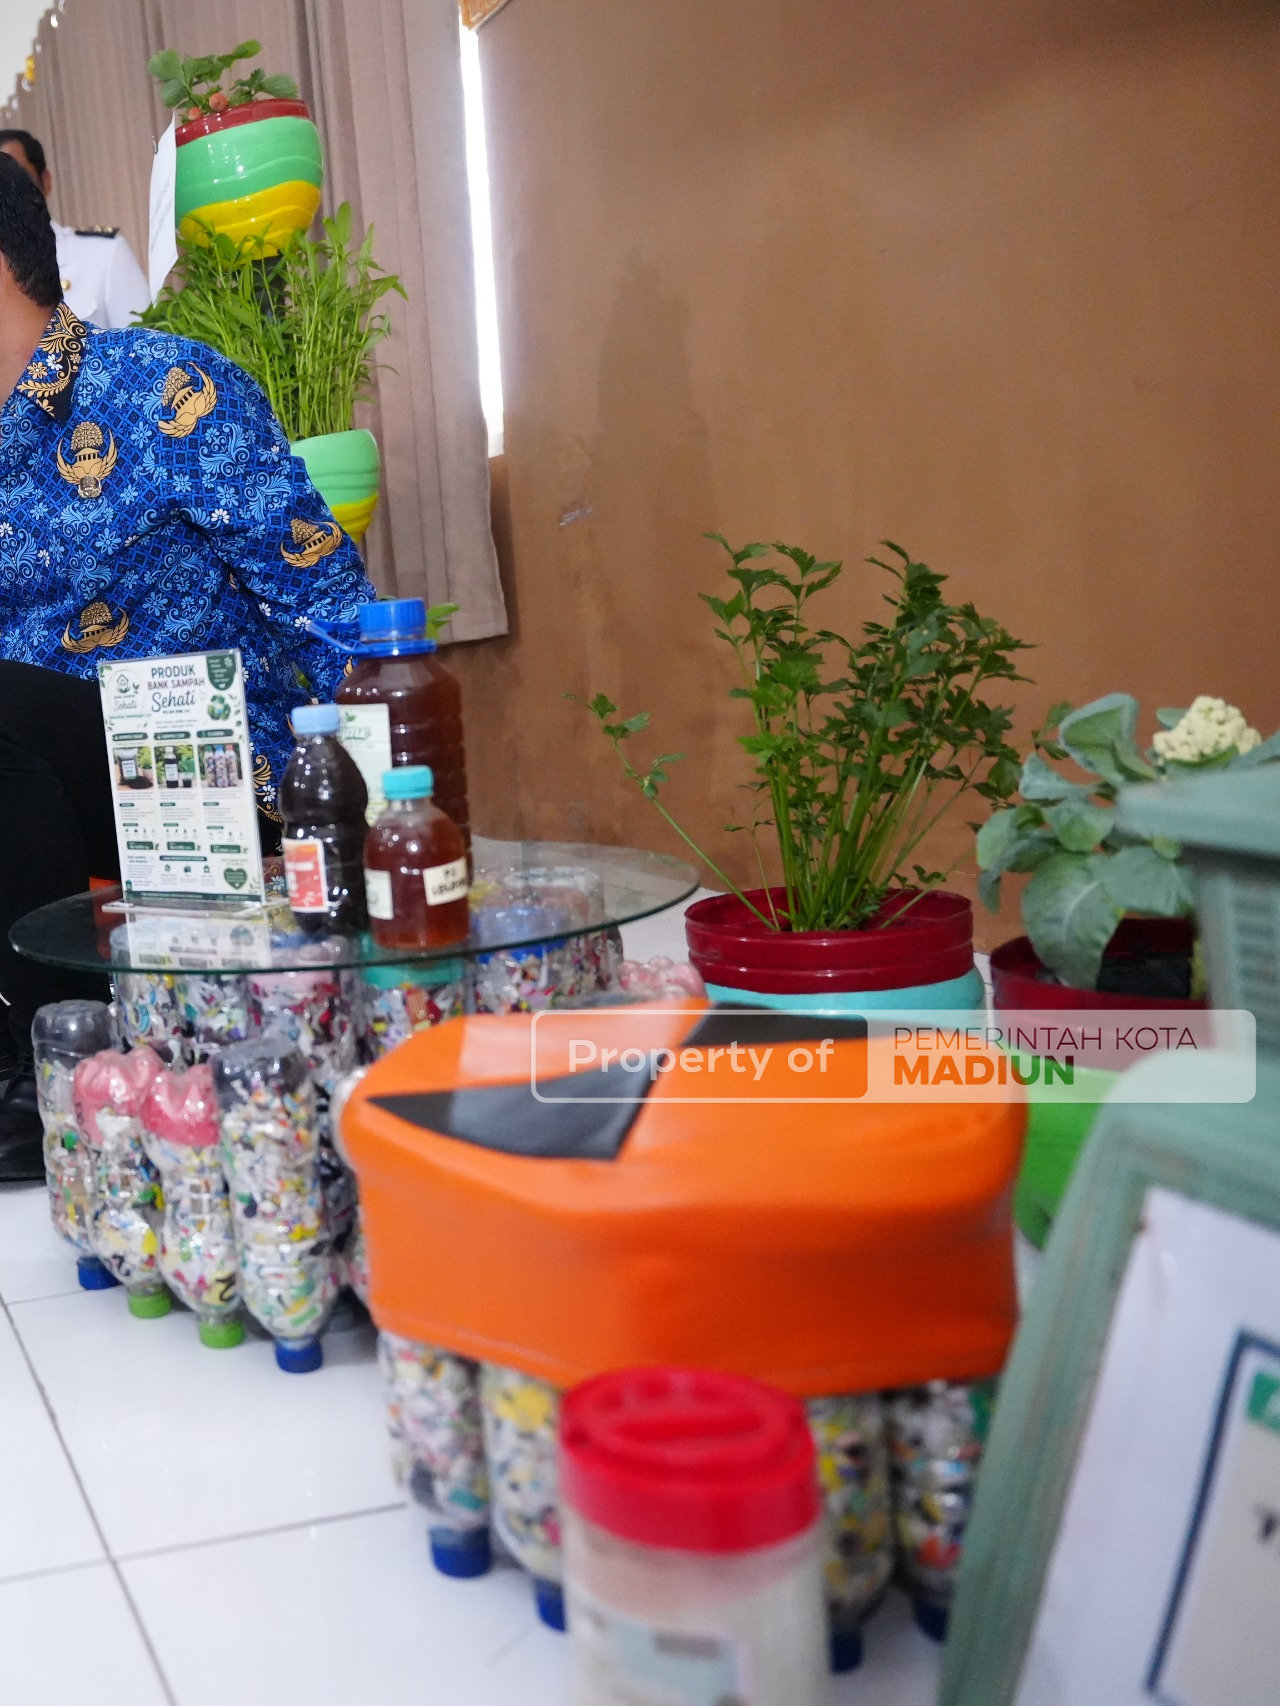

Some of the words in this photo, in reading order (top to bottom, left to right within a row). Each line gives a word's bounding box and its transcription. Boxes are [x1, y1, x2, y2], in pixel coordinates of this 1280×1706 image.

[151, 664, 195, 679] PRODUK
[147, 680, 169, 691] BANK
[171, 678, 205, 690] SAMPAH
[151, 690, 196, 713] Sehati
